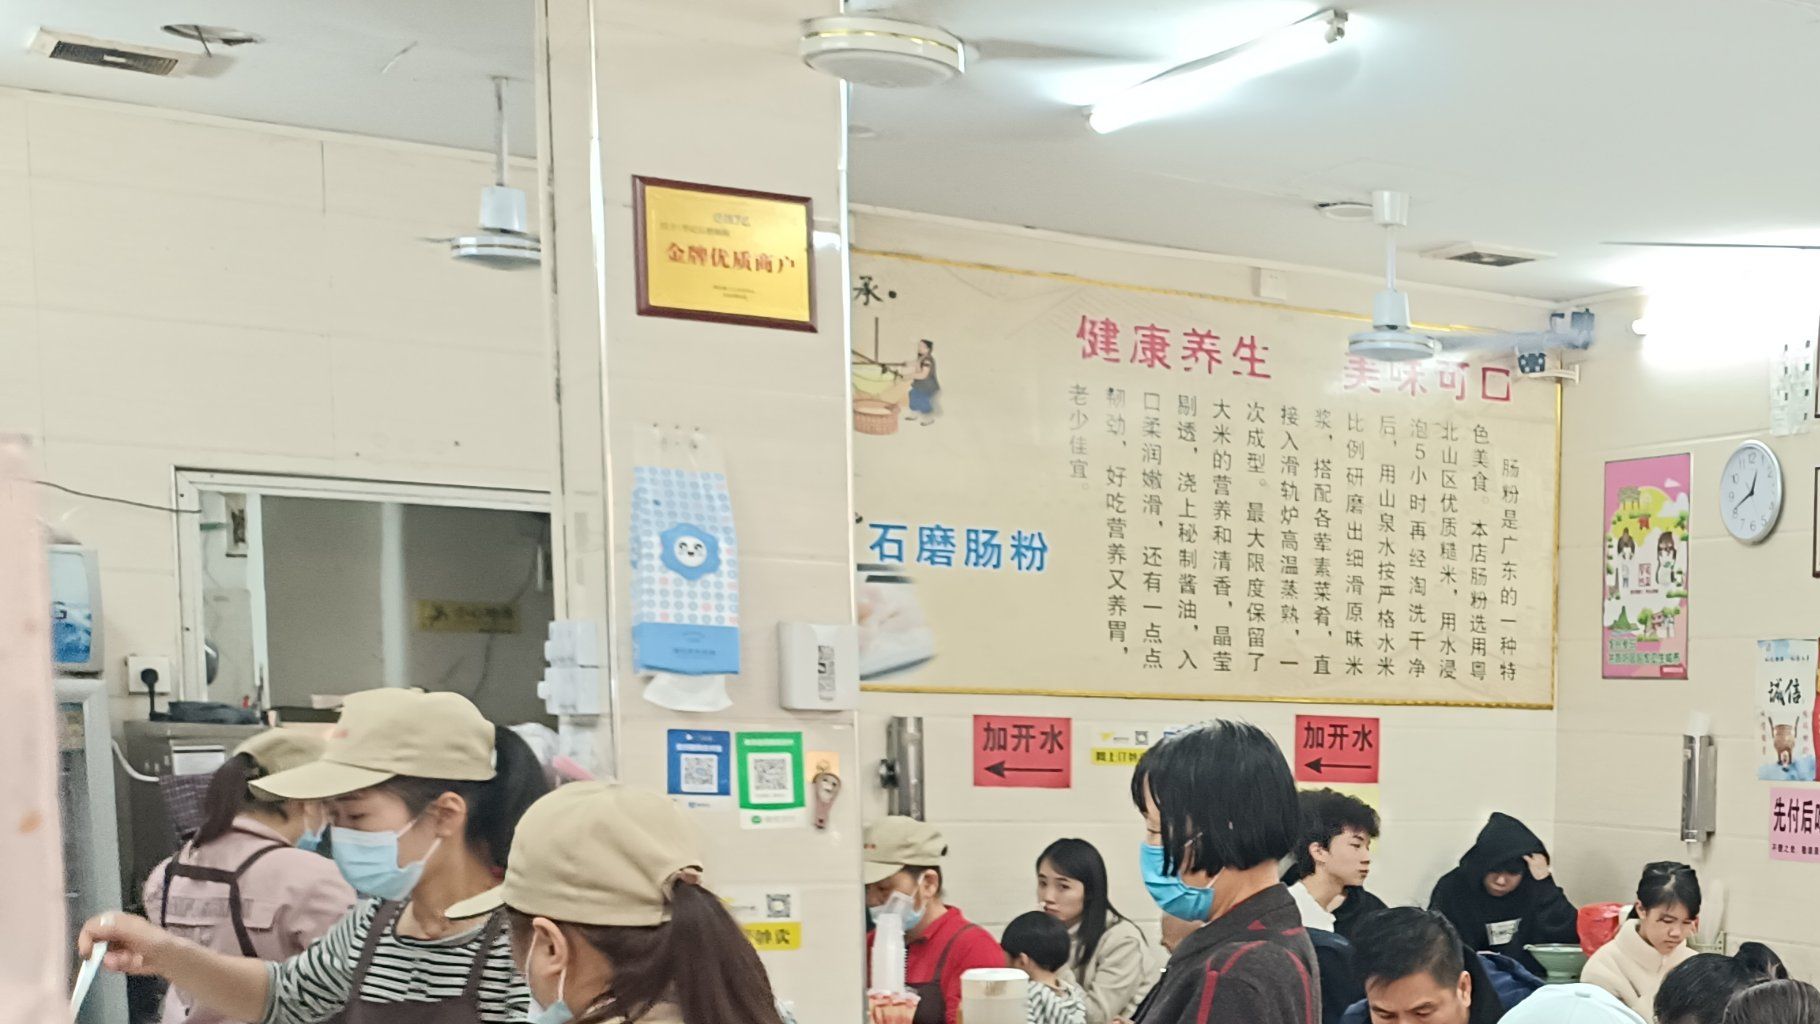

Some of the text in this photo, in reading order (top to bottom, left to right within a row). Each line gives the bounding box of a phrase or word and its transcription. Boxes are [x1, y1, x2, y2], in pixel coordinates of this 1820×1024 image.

[668, 242, 795, 273] 金牌优质商户
[1076, 314, 1272, 380] 健康养生
[1344, 352, 1512, 402] 美味可口
[869, 523, 1048, 571] 石磨肠粉
[1500, 458, 1520, 681] 肠粉是广东的一种特
[982, 721, 1064, 754] 加开水
[1303, 721, 1374, 753] 加开水
